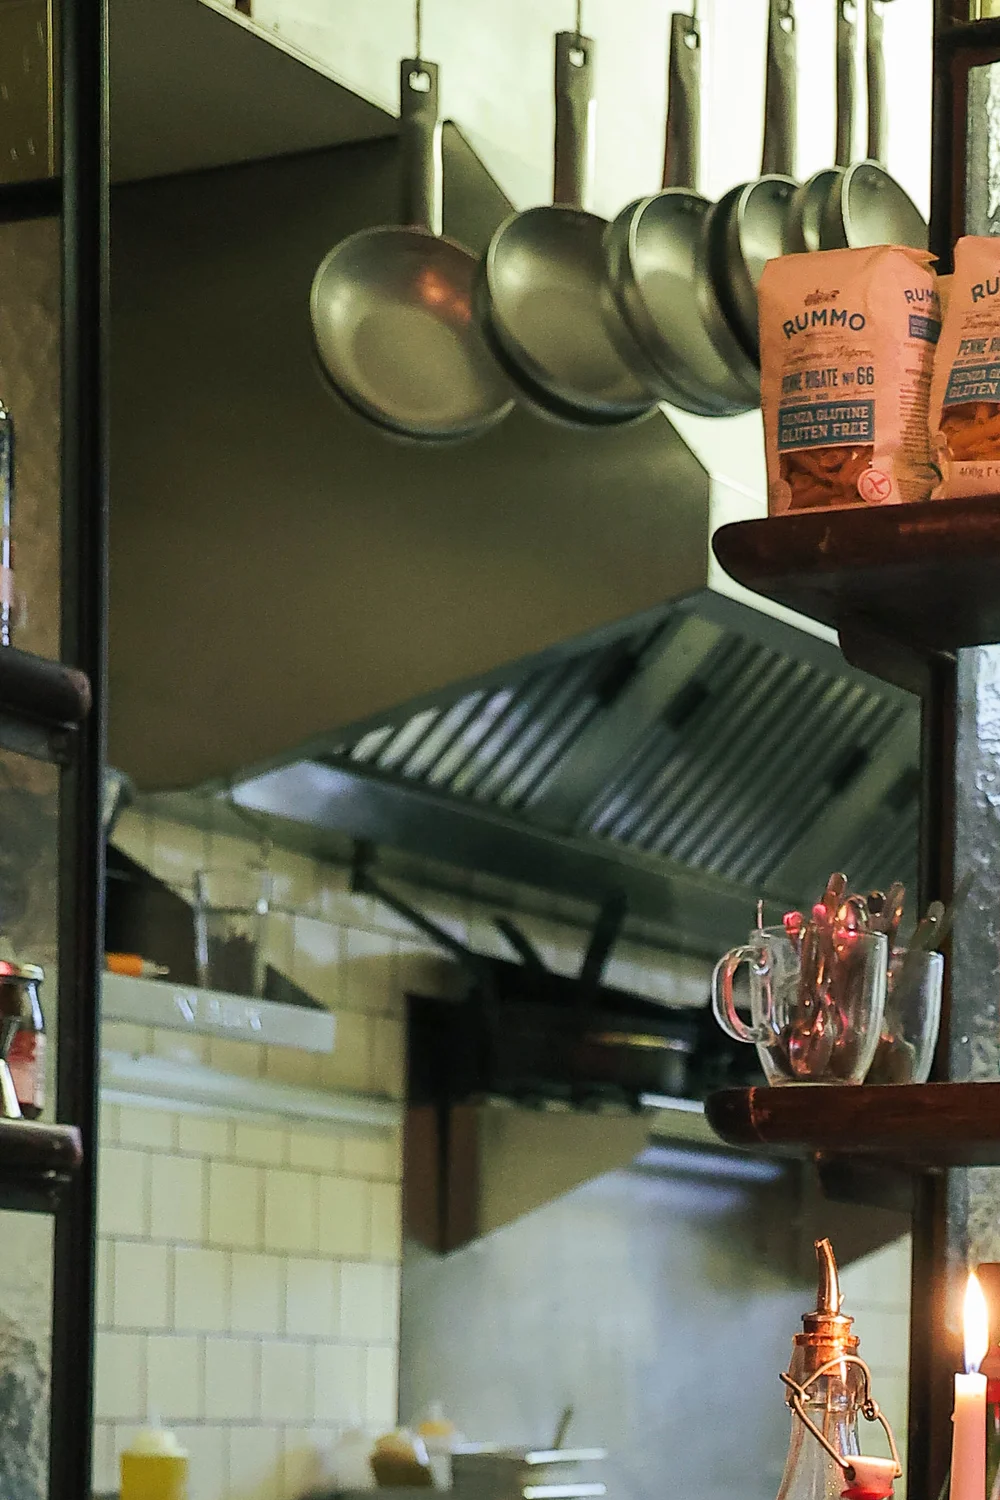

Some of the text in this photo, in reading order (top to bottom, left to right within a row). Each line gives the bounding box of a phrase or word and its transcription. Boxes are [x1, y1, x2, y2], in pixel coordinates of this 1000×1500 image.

[782, 308, 866, 339] RUMMO
[856, 365, 875, 386] 66
[949, 382, 998, 399] GLUTEN
[816, 405, 870, 421] GLUTINE
[781, 421, 870, 443] GLUTEN FREE
